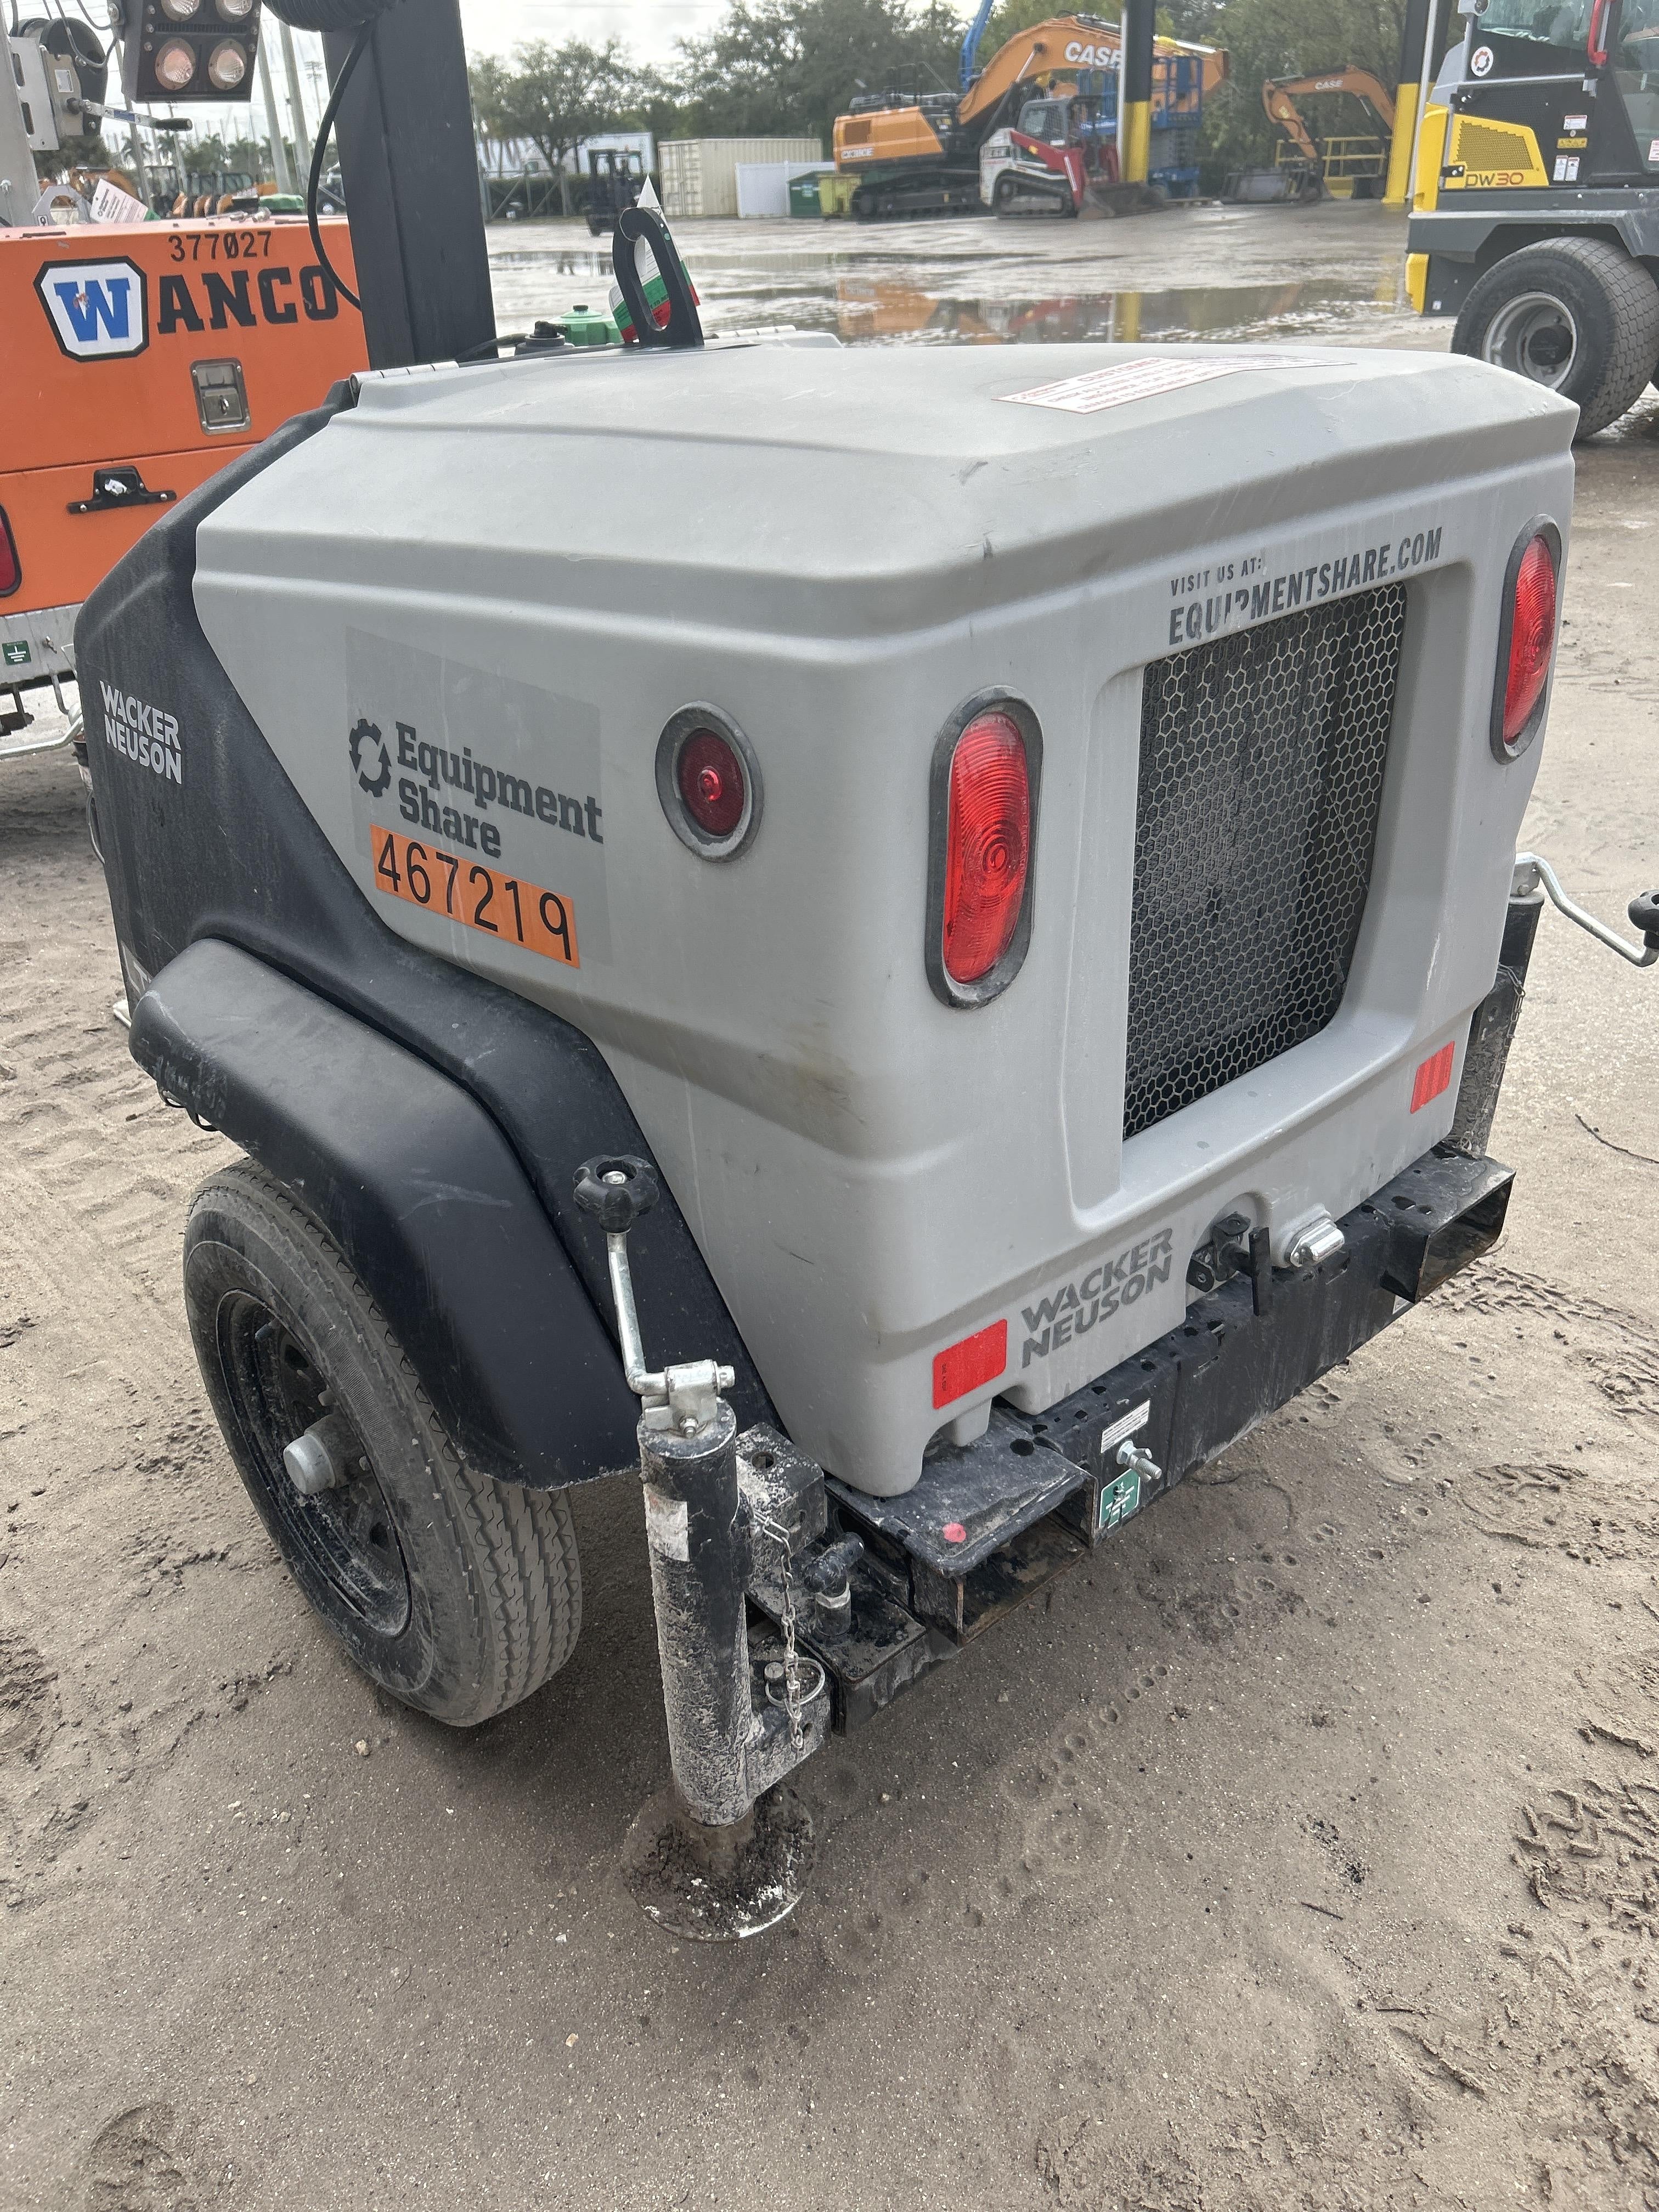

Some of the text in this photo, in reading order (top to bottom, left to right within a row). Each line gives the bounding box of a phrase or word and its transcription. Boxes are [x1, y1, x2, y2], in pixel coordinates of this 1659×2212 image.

[1315, 80, 1343, 89] CASE
[1465, 172, 1524, 186] DW30
[168, 231, 272, 262] 377027
[1077, 358, 1165, 382] CUSTOMER
[1171, 557, 1262, 596] VISIT US AT:
[99, 680, 182, 751] WACKER
[104, 714, 182, 785] NEUSON
[396, 721, 604, 844] Equipment
[398, 777, 501, 859] Share
[377, 833, 572, 961] 467219
[1020, 1228, 1173, 1334] WACKER
[1022, 1254, 1172, 1369] NEUSON
